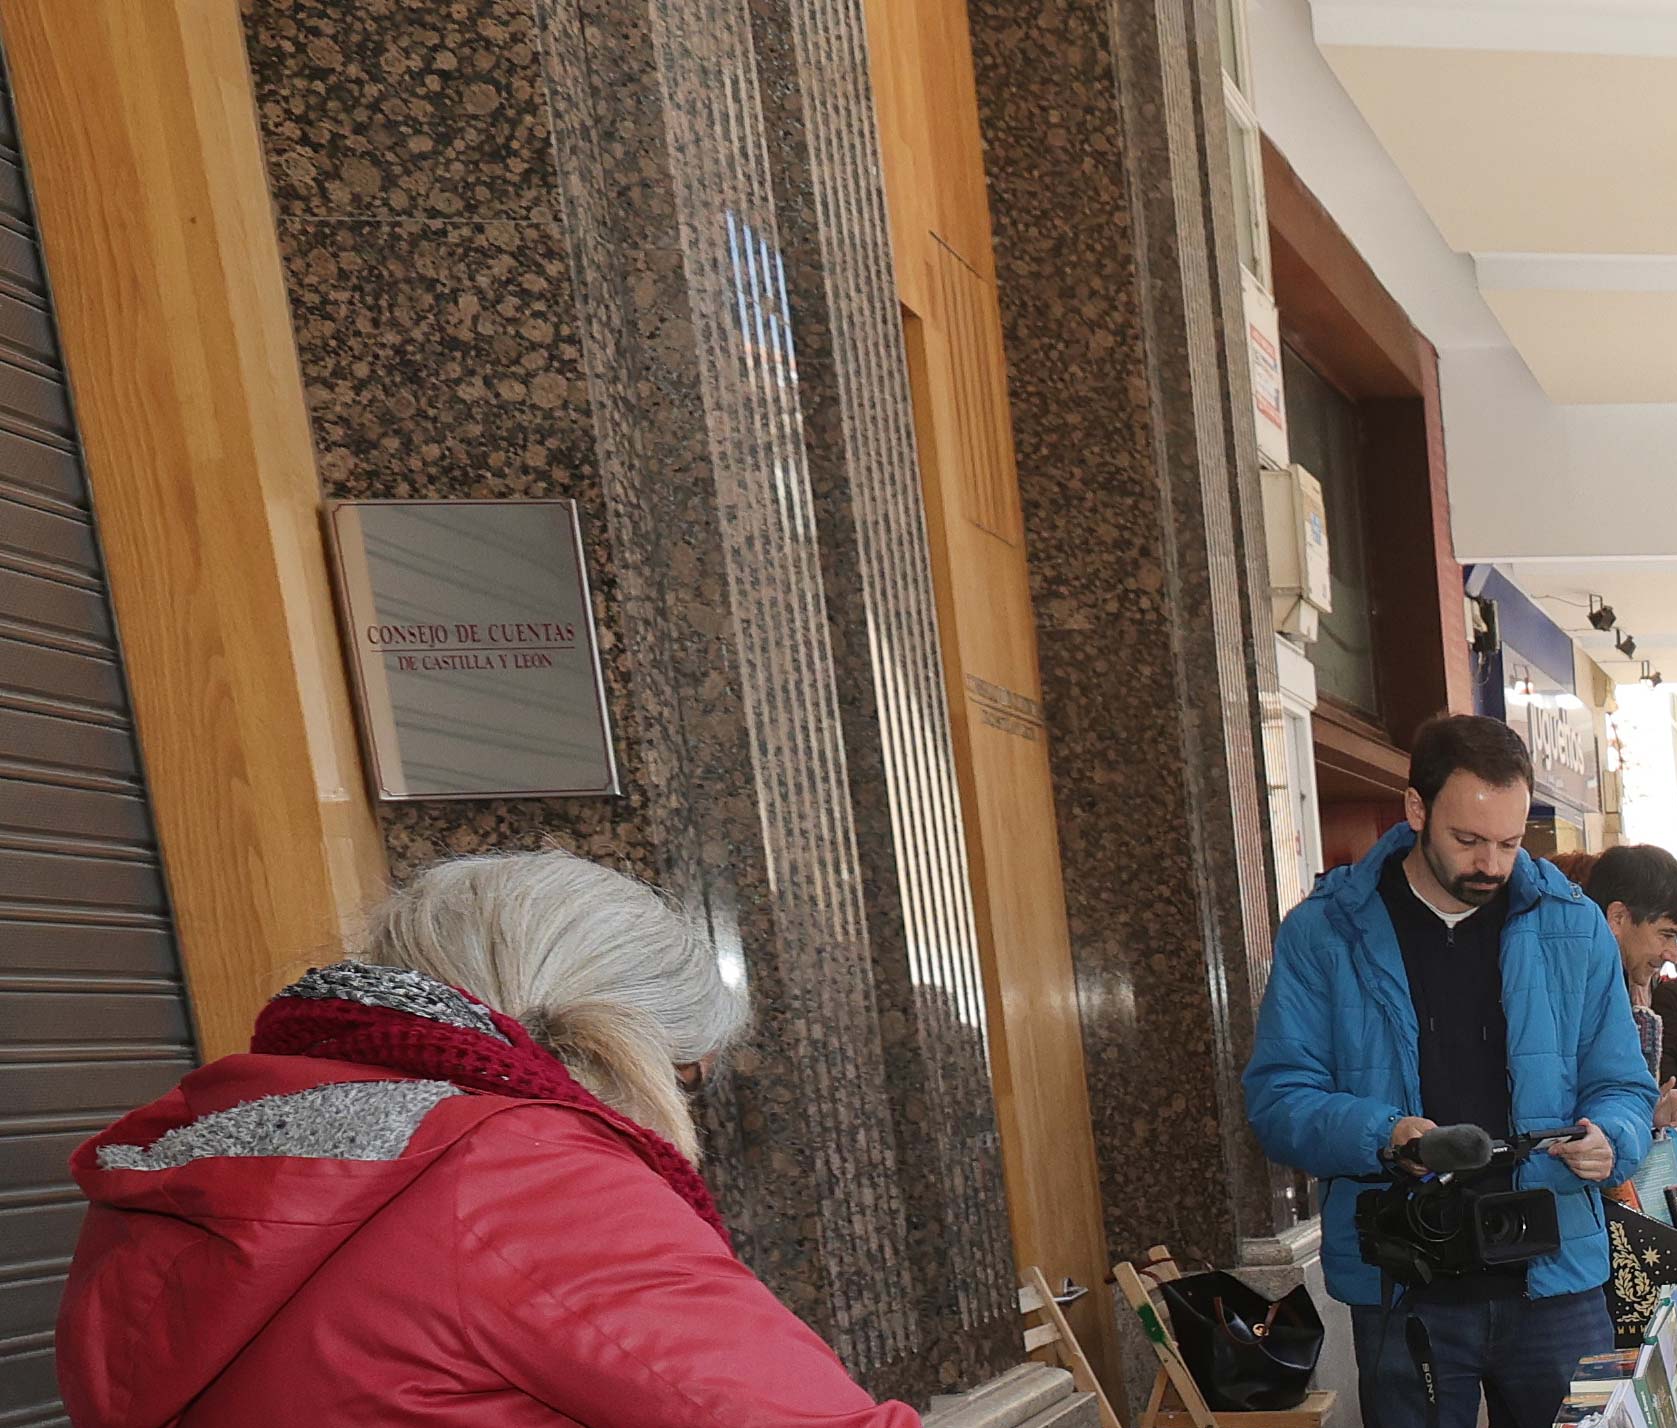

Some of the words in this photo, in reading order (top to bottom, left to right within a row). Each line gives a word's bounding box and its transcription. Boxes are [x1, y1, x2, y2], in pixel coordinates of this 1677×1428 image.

[366, 623, 448, 647] CONSEJO
[454, 623, 482, 644] DE
[487, 622, 575, 644] CUENTAS
[397, 654, 419, 672] DE
[421, 654, 495, 671] CASTILLA
[499, 653, 509, 669] Y
